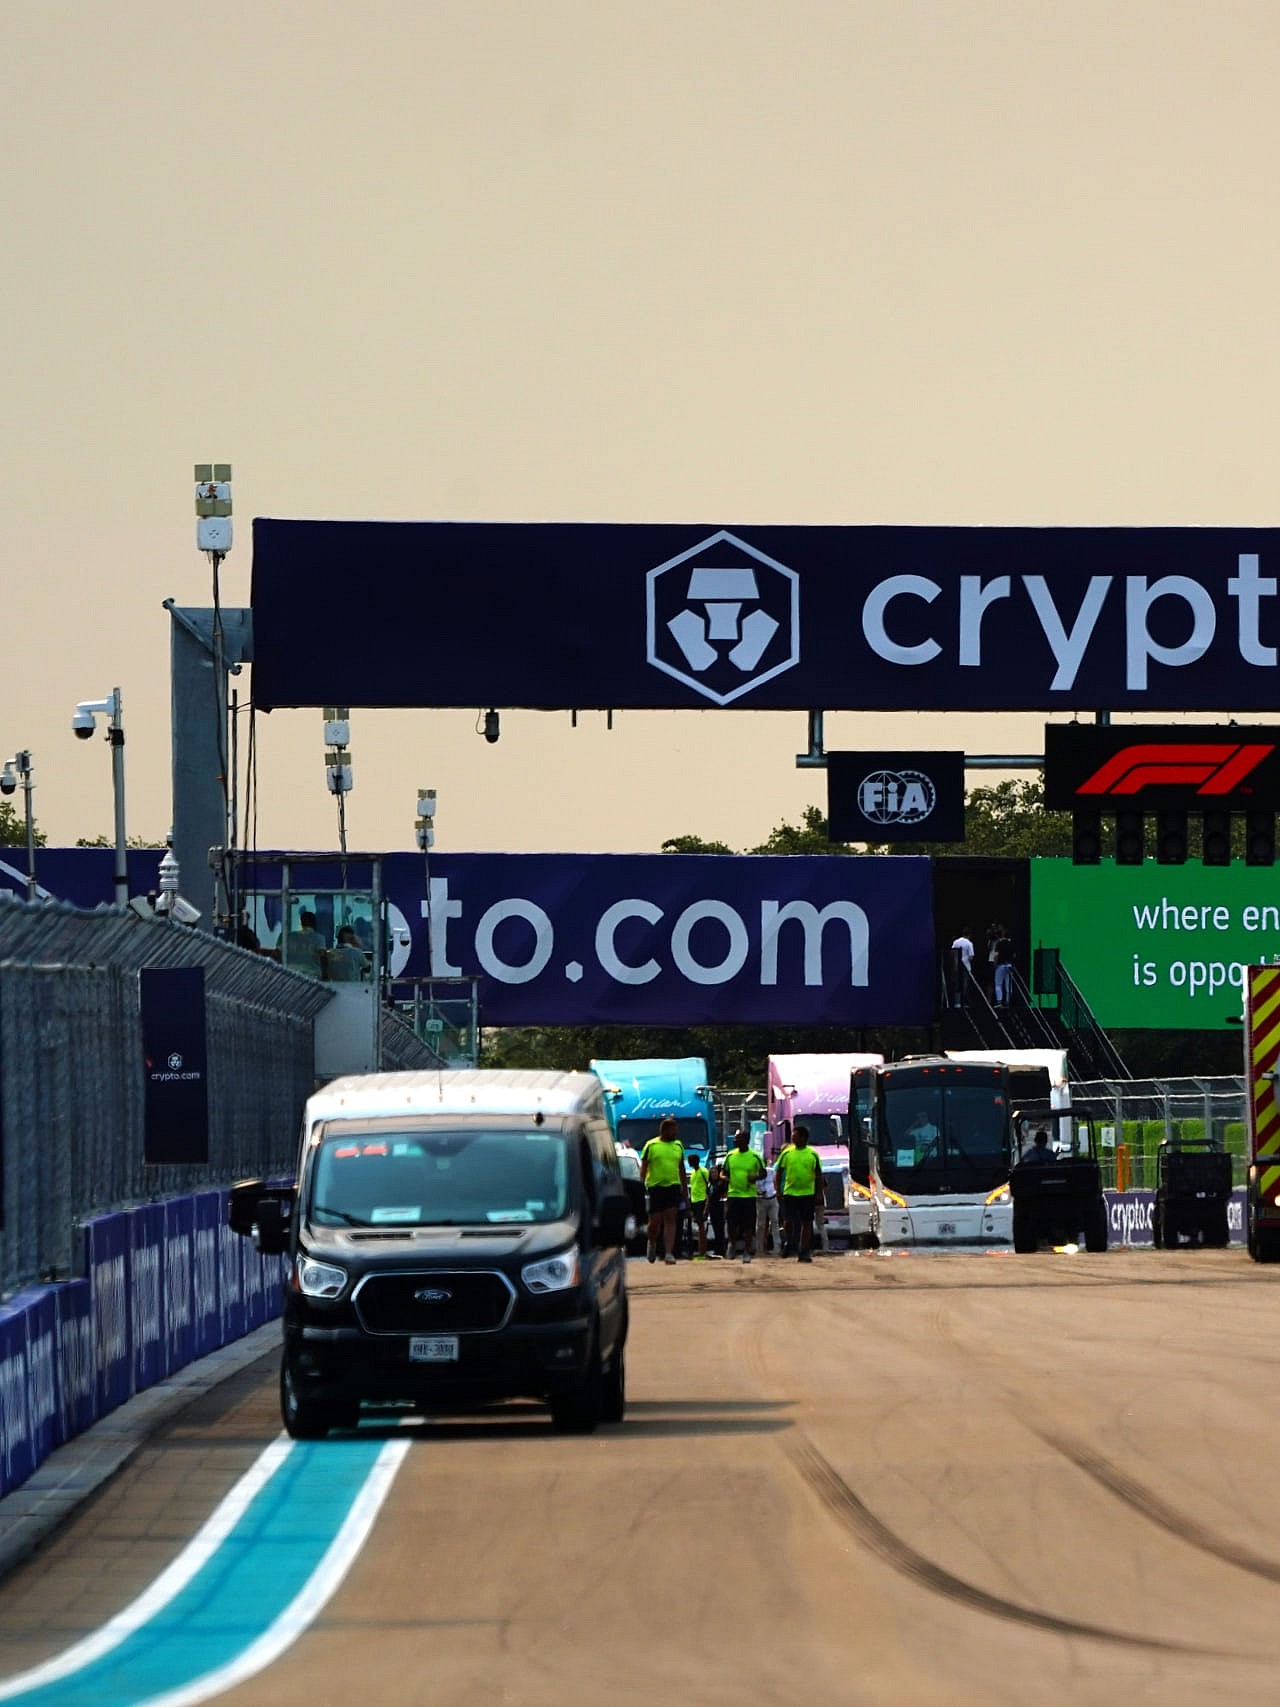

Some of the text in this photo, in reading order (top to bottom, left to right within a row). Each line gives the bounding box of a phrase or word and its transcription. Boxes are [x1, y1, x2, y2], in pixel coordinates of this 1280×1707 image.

[1133, 897, 1229, 931] where
[1134, 954, 1157, 985] is
[150, 1071, 201, 1082] crypto.com
